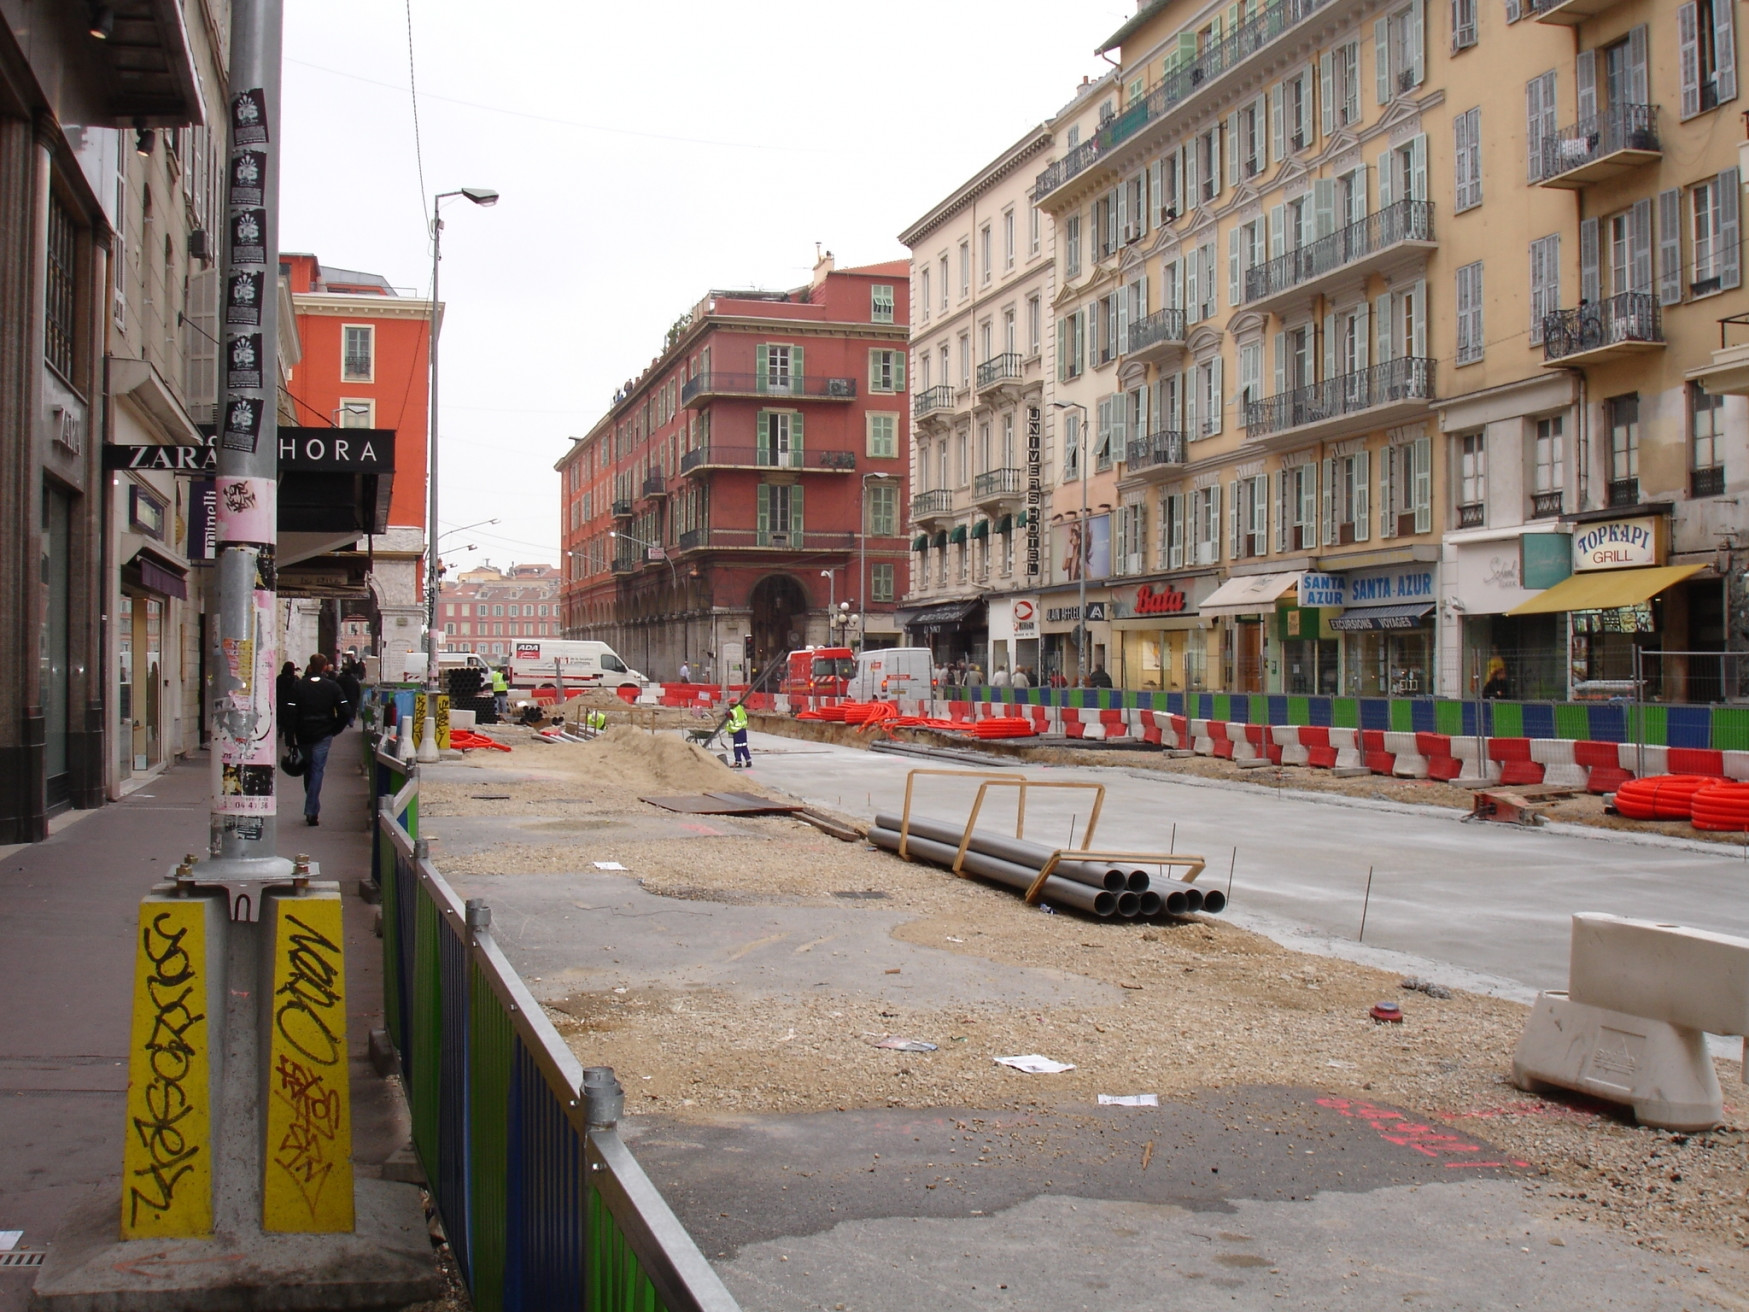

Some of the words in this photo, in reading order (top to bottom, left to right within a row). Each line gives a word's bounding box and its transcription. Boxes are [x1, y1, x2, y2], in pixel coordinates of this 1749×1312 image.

[129, 446, 216, 468] ZARA
[1028, 409, 1040, 504] UNIVERS
[1027, 509, 1040, 575] HOTEL
[1578, 524, 1650, 555] TOPKAPI
[1593, 550, 1633, 563] GRILL
[1304, 576, 1346, 589] SANTA
[1353, 577, 1391, 601] SANTA
[1397, 573, 1432, 597] AZUR
[1134, 585, 1186, 613] Bata
[1307, 591, 1343, 605] AZUR
[1331, 618, 1373, 630] EXCURSIONS
[1379, 617, 1412, 628] VOYAGES
